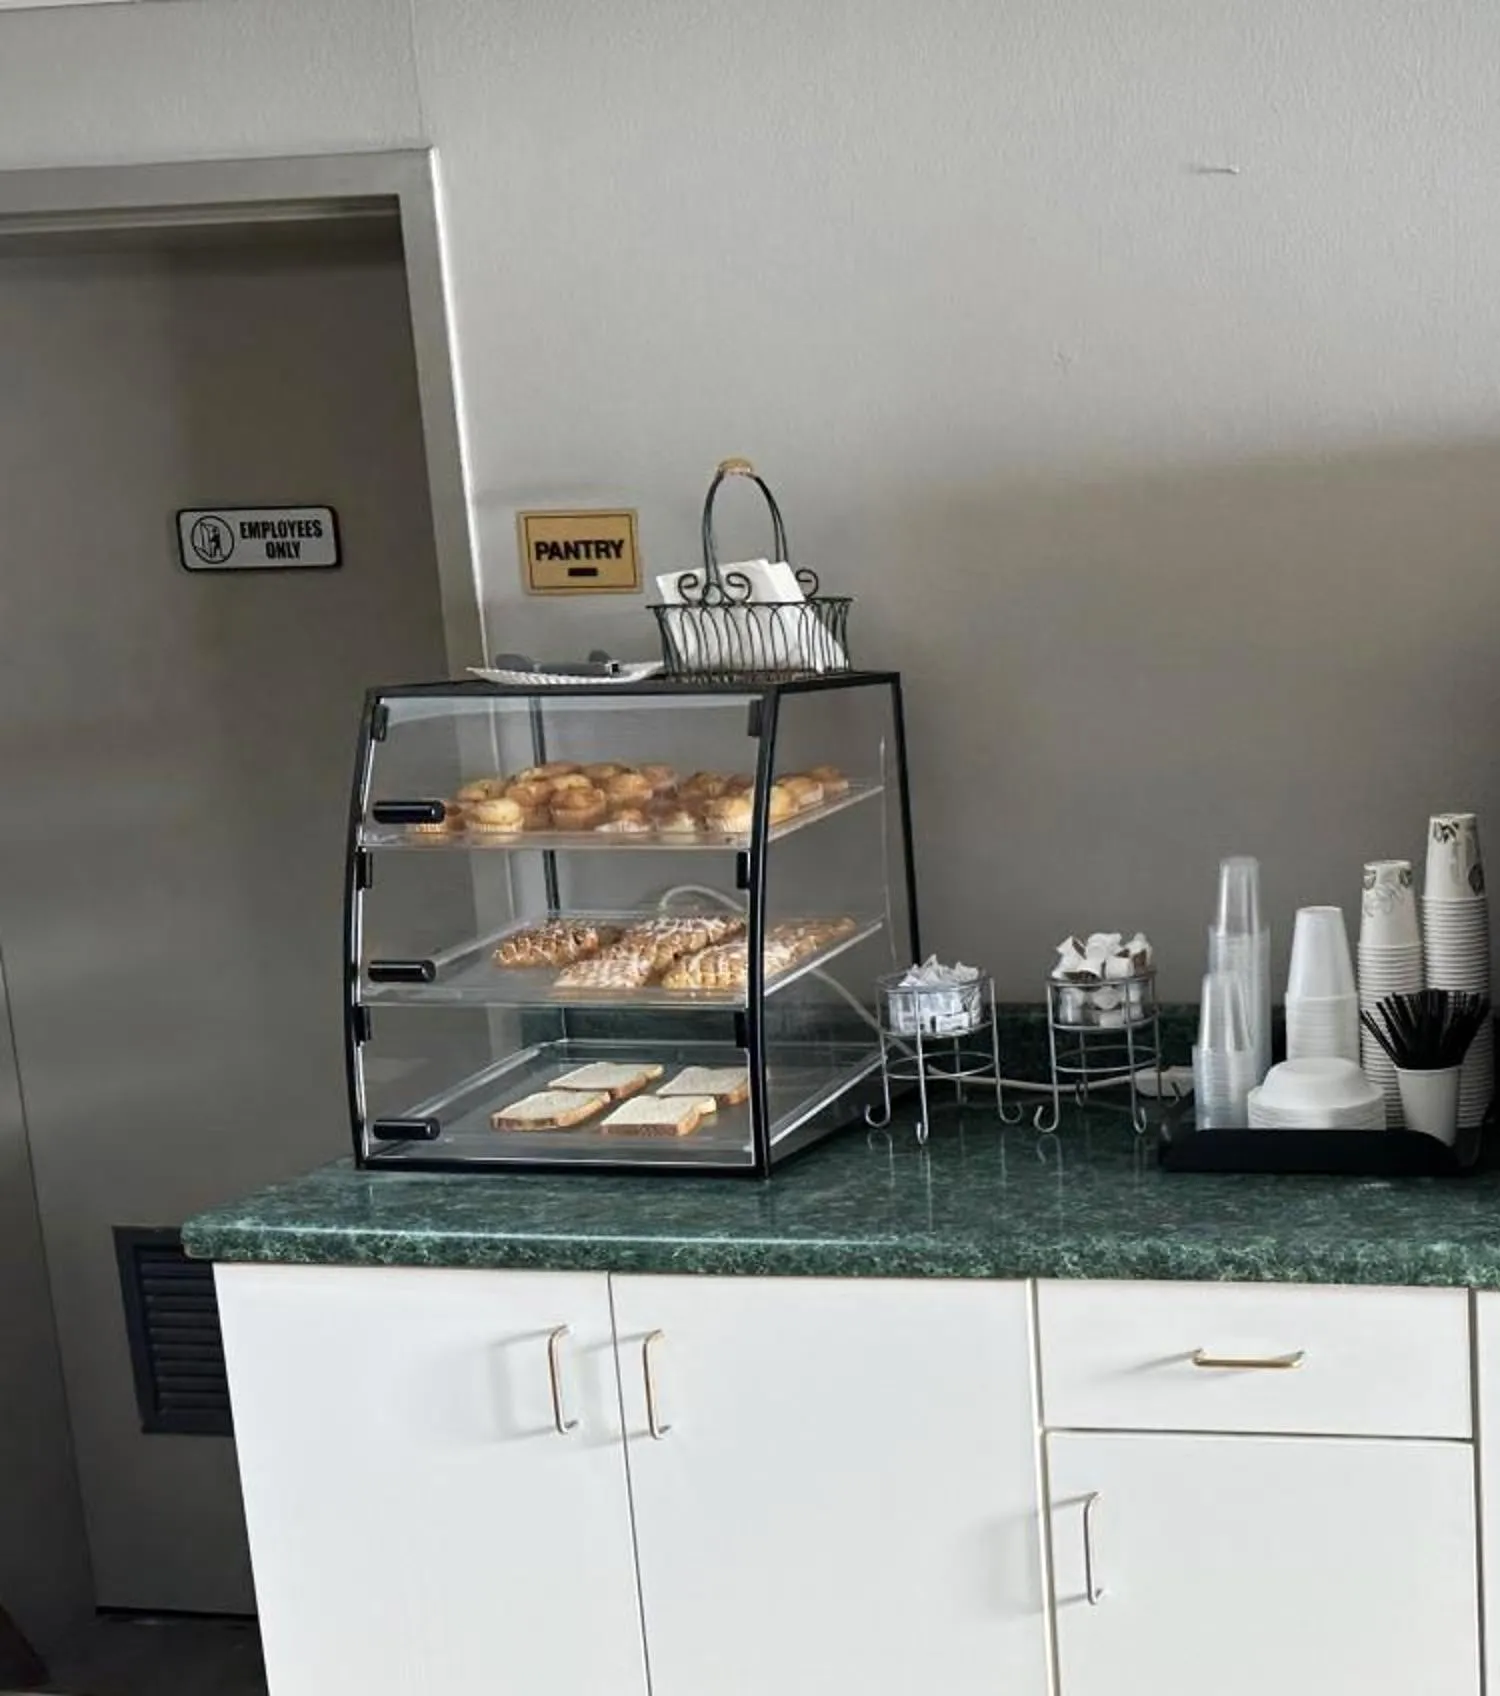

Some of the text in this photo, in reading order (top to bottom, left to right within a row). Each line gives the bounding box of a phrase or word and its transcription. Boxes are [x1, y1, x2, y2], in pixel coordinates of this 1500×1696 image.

[239, 519, 323, 540] EMPLOYEES
[265, 540, 302, 559] ONLY
[534, 539, 625, 562] PANTRY
